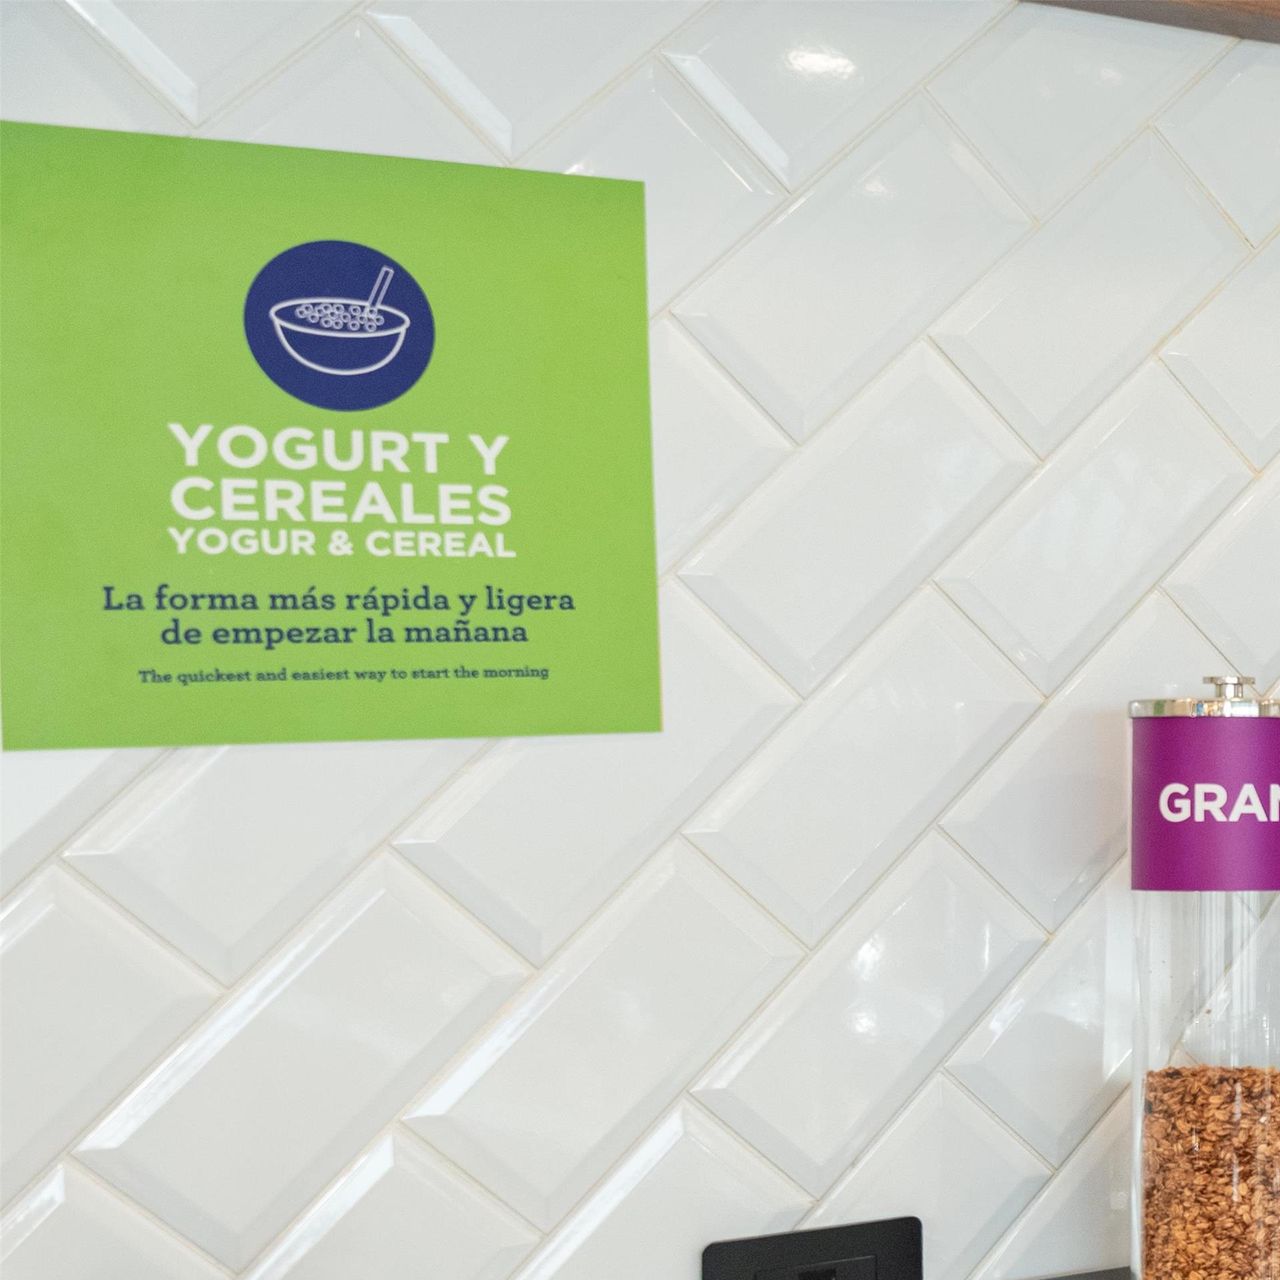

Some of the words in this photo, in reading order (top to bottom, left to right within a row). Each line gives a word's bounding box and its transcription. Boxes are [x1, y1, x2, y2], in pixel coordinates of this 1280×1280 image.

[168, 423, 449, 474] YOGURT
[468, 434, 510, 476] Y
[170, 477, 512, 526] CEREALES
[167, 527, 317, 557] YOGUR
[329, 530, 354, 557] &
[365, 530, 517, 558] CEREAL
[102, 585, 145, 611] La
[155, 584, 259, 611] forma
[269, 585, 336, 611] más
[345, 584, 450, 617] rápida
[458, 593, 478, 617] y
[485, 584, 576, 617] ligera
[161, 618, 203, 645] de
[212, 626, 357, 651] empezar
[366, 618, 395, 643] la
[404, 620, 529, 643] mañana
[139, 668, 173, 684] The
[177, 668, 252, 686] quickest
[256, 667, 287, 682] and
[292, 668, 350, 681] easiest
[355, 669, 386, 683] way
[391, 668, 408, 680] to
[412, 668, 450, 680] start
[453, 666, 480, 679] the
[483, 665, 550, 681] morning
